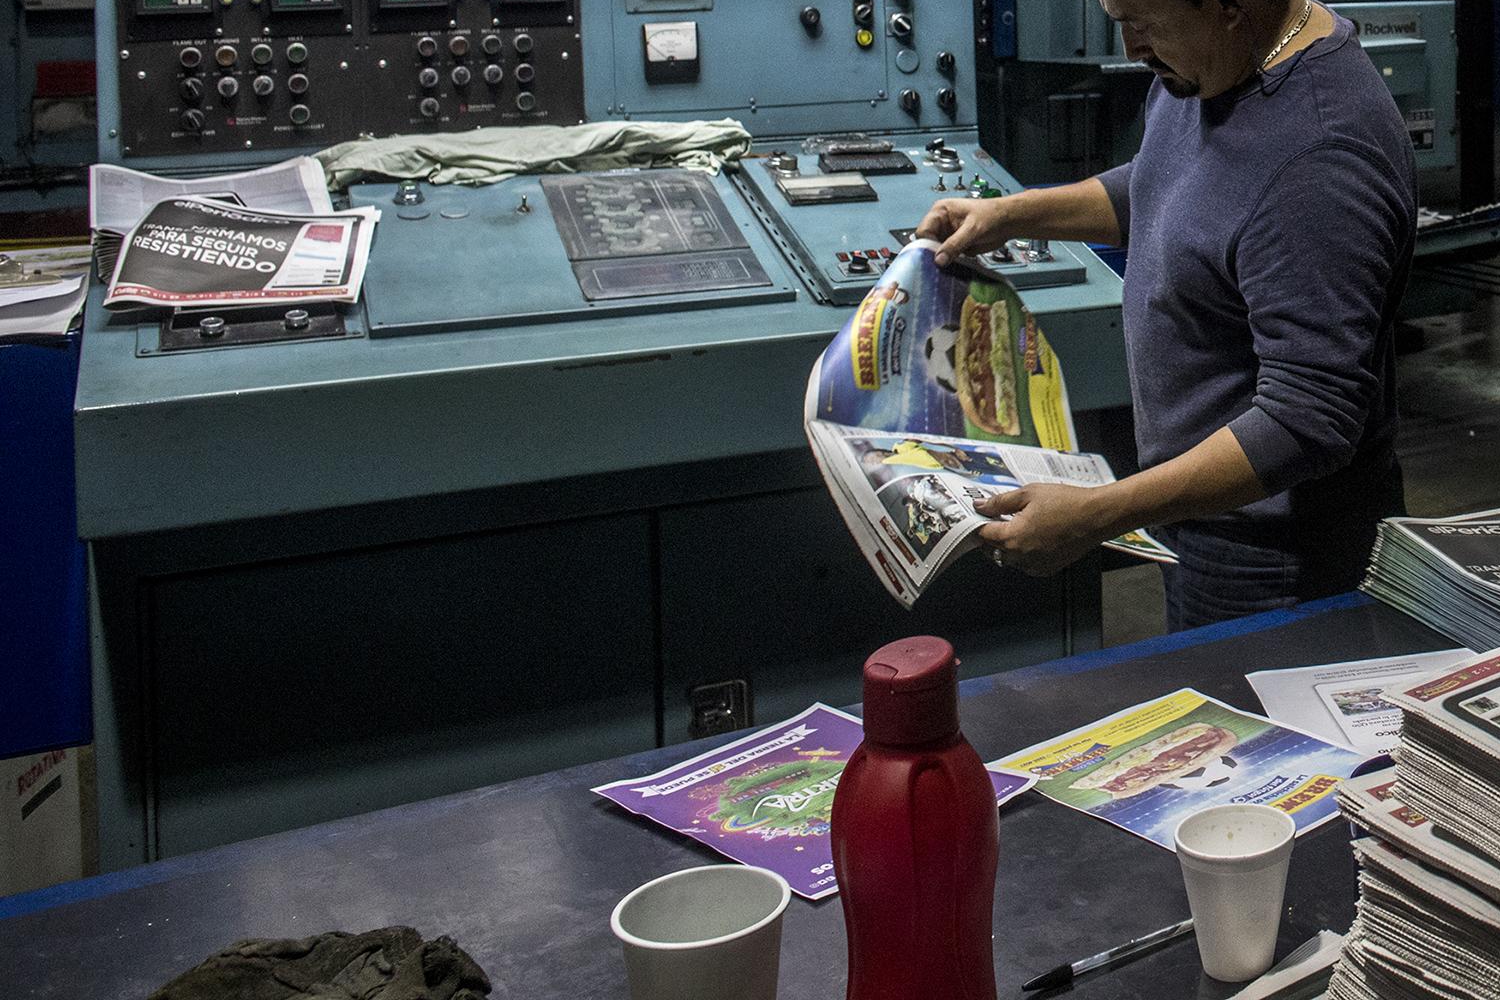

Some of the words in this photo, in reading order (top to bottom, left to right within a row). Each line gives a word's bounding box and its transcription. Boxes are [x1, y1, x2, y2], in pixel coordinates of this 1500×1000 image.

[1364, 21, 1417, 36] Rockwell
[149, 229, 188, 245] PARA
[191, 235, 259, 259] SEGUIR
[132, 234, 277, 274] RESISTIENDO
[725, 752, 750, 766] DEL
[751, 740, 784, 759] TIERRA
[661, 774, 696, 793] PUEDE
